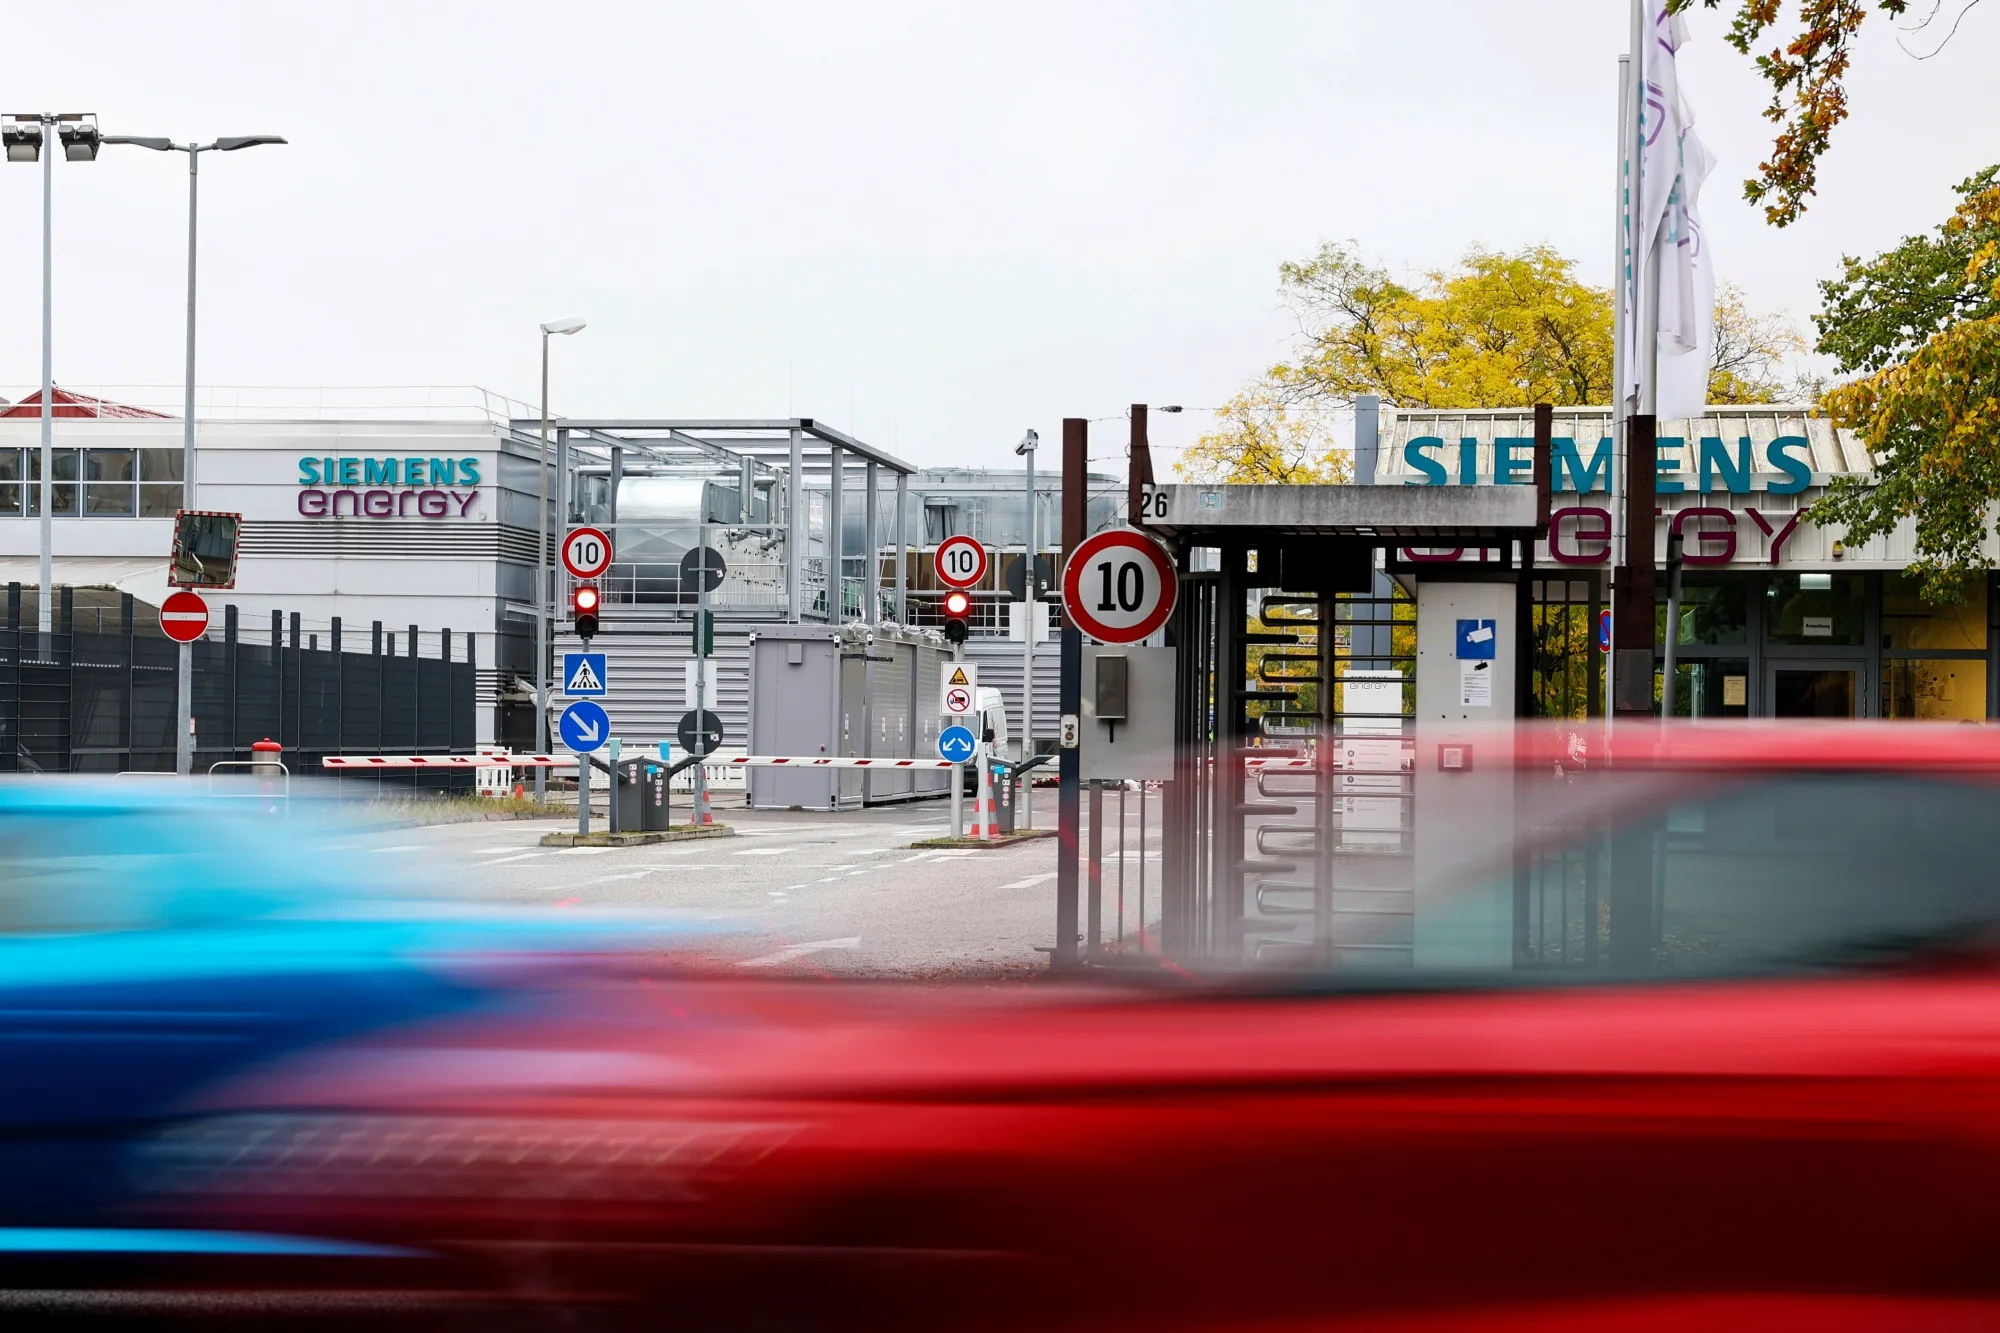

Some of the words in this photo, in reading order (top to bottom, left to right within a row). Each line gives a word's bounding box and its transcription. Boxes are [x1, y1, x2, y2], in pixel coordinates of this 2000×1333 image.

[298, 457, 481, 485] SIEMENS
[1403, 436, 1812, 495] SIEMENS
[575, 541, 599, 565] 10
[948, 550, 973, 573] 10
[1096, 561, 1144, 612] 10
